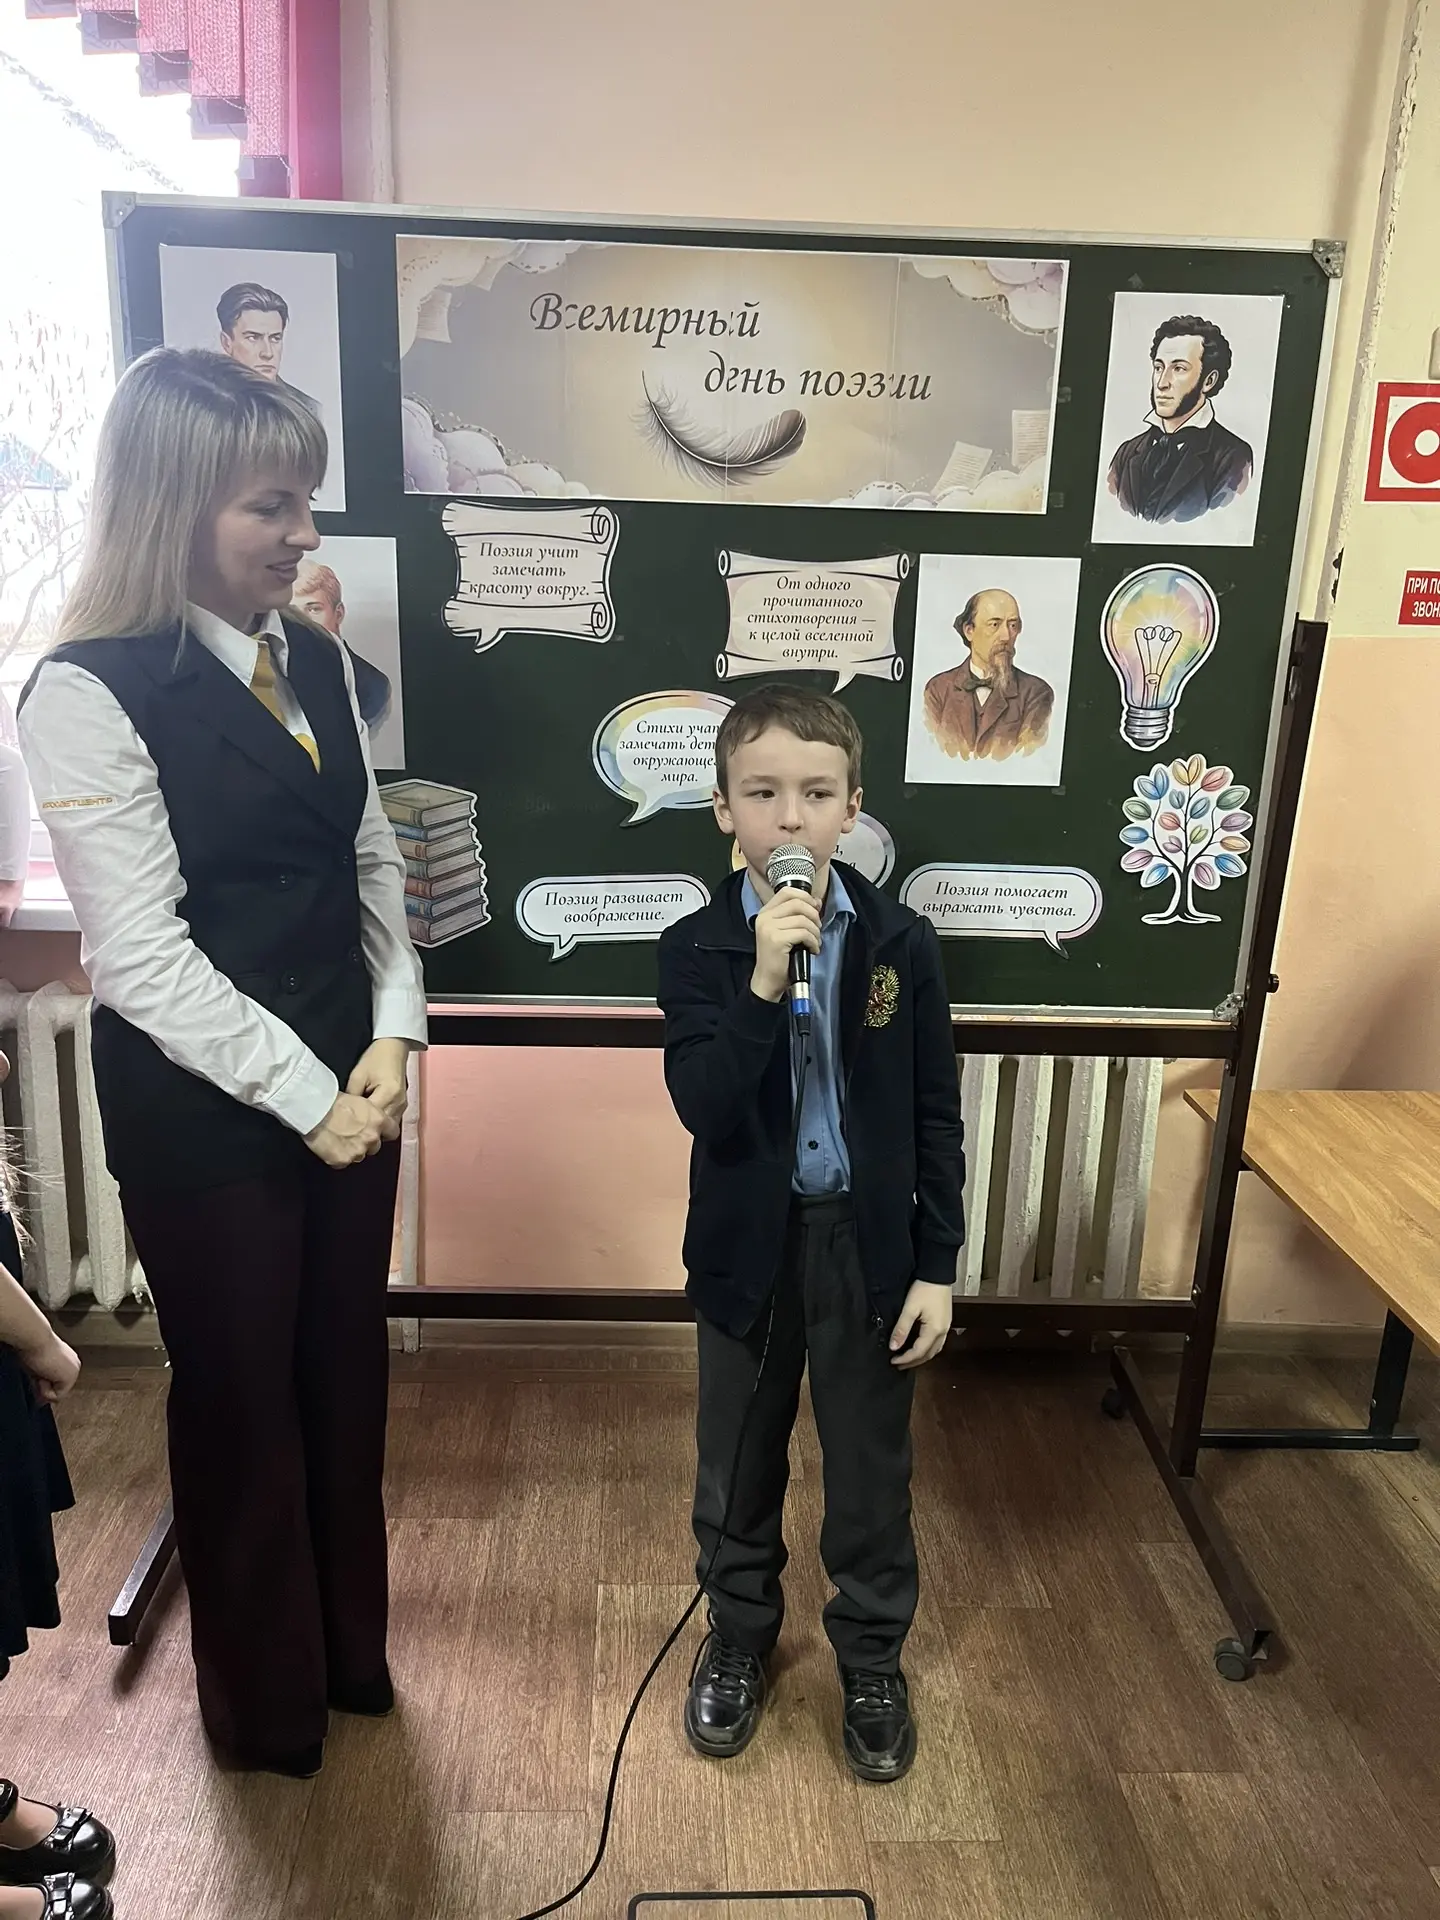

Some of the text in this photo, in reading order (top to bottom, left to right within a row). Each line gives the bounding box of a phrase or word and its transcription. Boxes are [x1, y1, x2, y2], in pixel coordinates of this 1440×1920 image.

[703, 350, 786, 396] день
[480, 542, 579, 562] Поэзия учит
[492, 564, 566, 577] замечать
[776, 574, 851, 591] От одного
[1406, 577, 1428, 594] ПРИ
[469, 583, 590, 600] красоту вокруг.
[763, 596, 863, 611] прочитанного
[1411, 600, 1440, 618] ЗВОН
[747, 612, 857, 628] стихотворения
[749, 629, 874, 645] к целой вселенной
[782, 649, 839, 662] внутри.
[636, 720, 683, 734] Стихи
[619, 735, 716, 750] замечать дет
[633, 756, 717, 770] окружающе
[660, 773, 698, 786] мира.
[935, 881, 1068, 899] Поэзия помогает
[545, 891, 683, 909] Поэзия развивает
[564, 907, 665, 926] воображение.
[922, 901, 1077, 919] выражать чувства.
